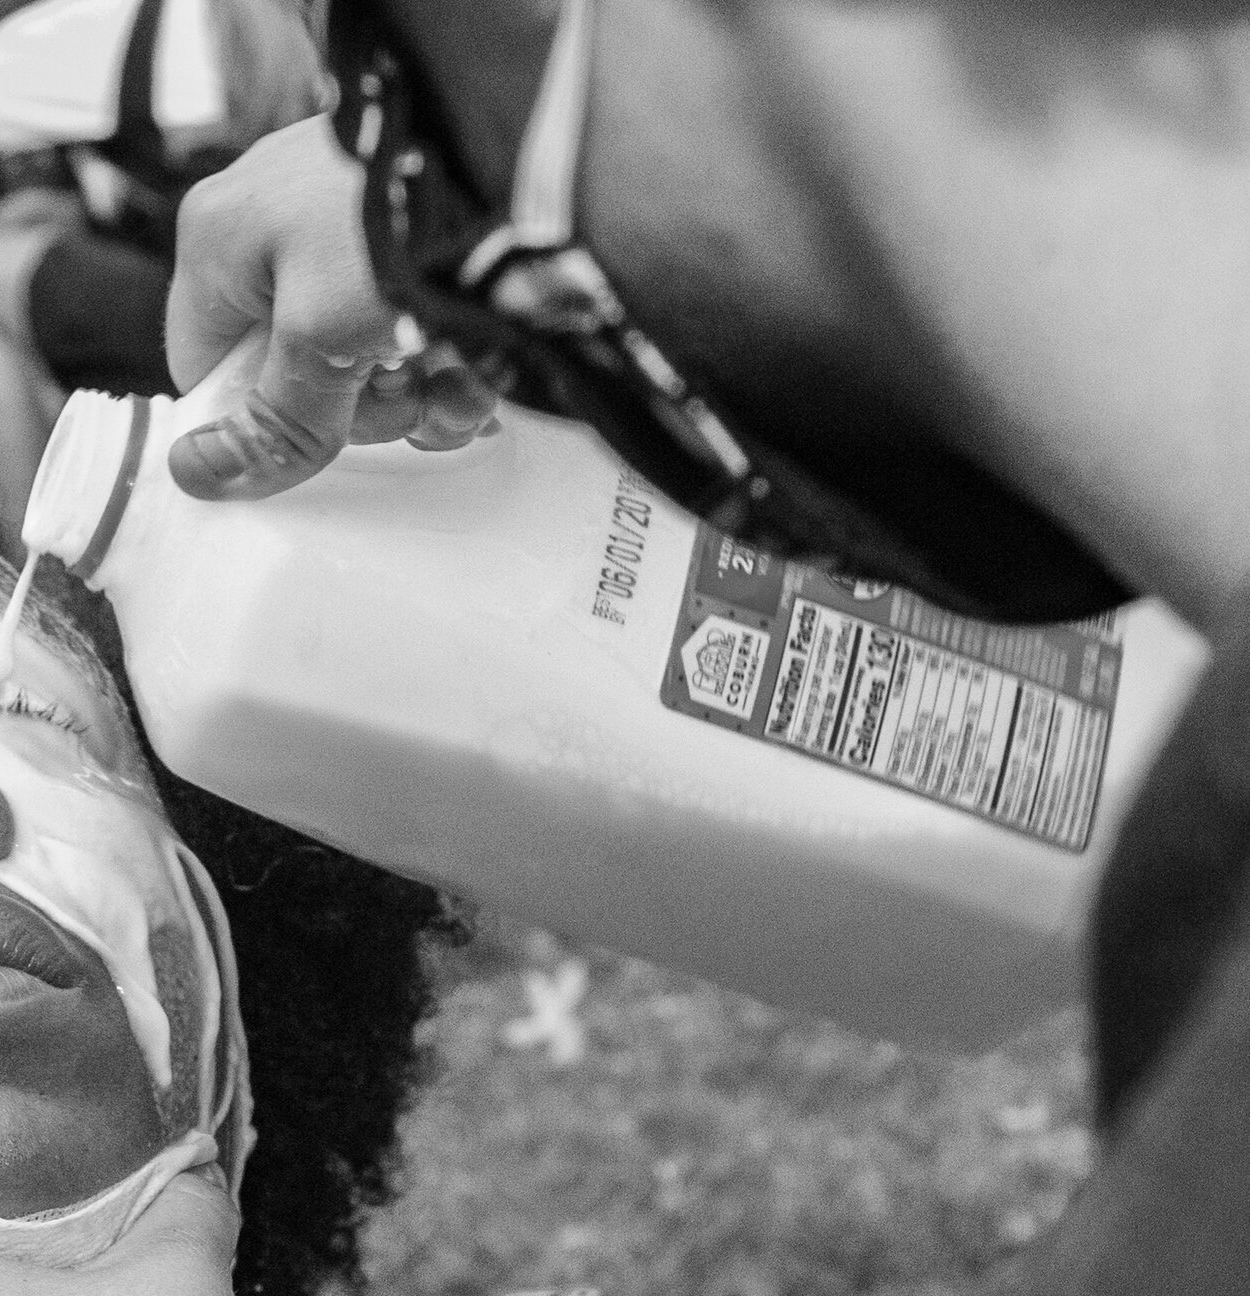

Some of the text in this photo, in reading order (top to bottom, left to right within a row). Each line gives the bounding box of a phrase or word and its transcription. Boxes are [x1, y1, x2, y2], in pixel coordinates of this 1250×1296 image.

[598, 495, 652, 600] 06/01/20
[726, 631, 753, 707] COBURN
[789, 605, 817, 655] Facts
[848, 678, 886, 765] Calories
